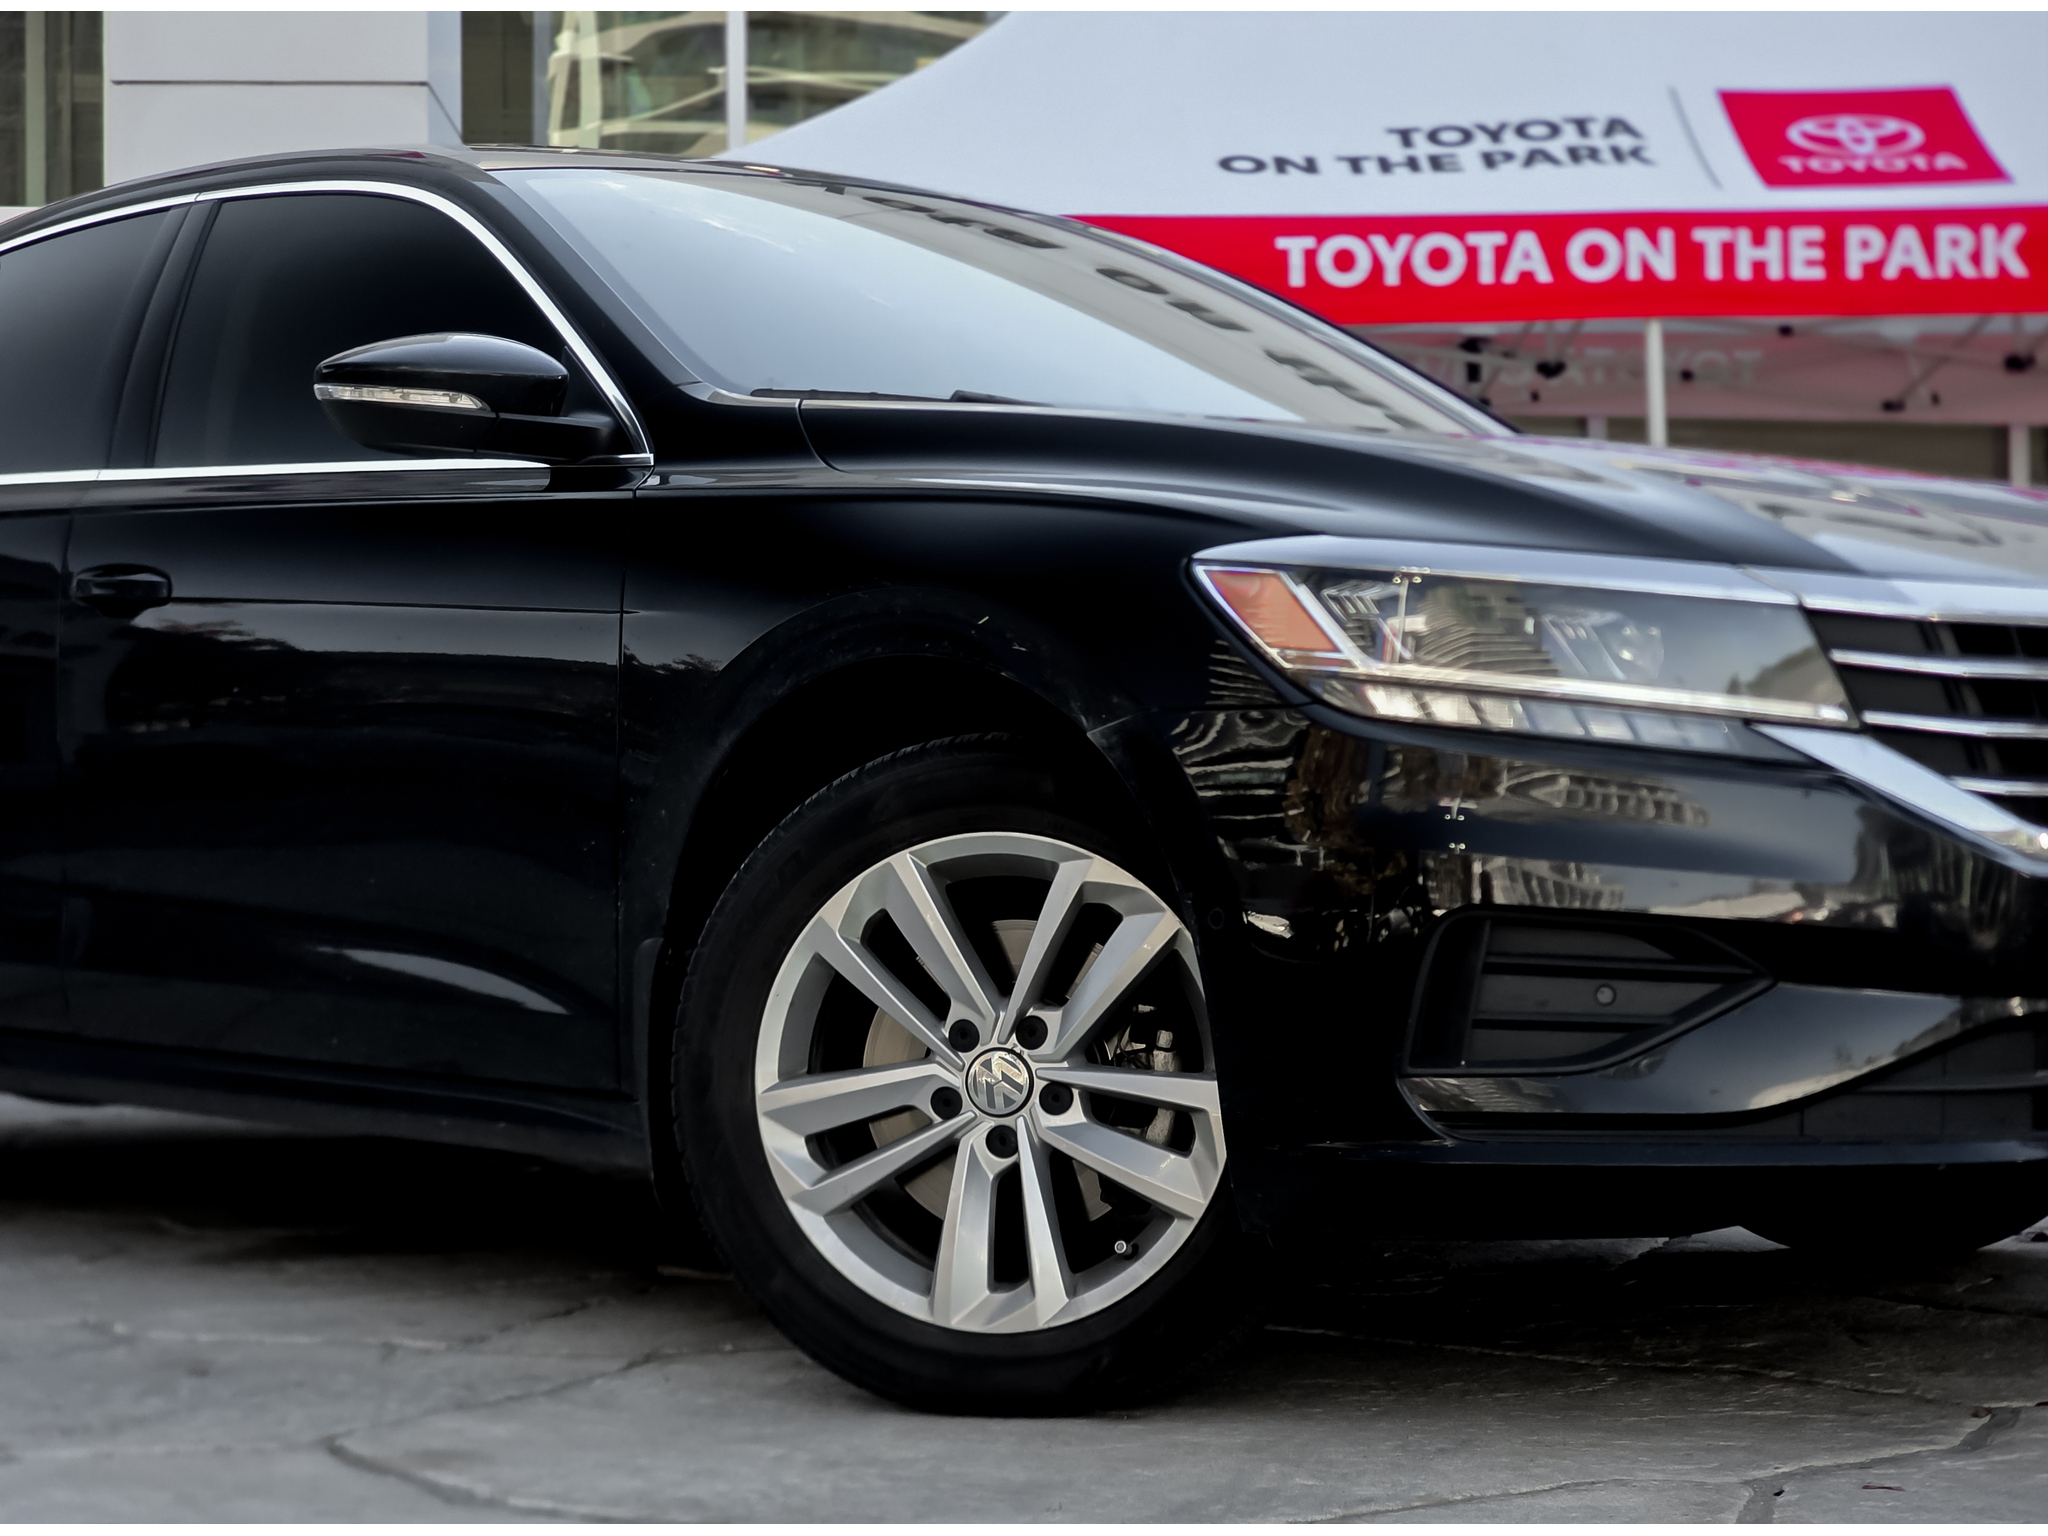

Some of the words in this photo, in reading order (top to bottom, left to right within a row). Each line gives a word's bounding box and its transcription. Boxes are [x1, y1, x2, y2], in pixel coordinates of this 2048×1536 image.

[1385, 116, 1643, 150] TOYOTA
[1217, 154, 1321, 175] ON
[1334, 153, 1463, 175] THE
[1479, 145, 1655, 170] PARK
[1778, 151, 1968, 174] TOYOTA
[1273, 229, 1554, 288] TOYOTA
[1565, 226, 1676, 284] ON
[1690, 224, 1827, 282] THE
[1843, 222, 2030, 281] PARK
